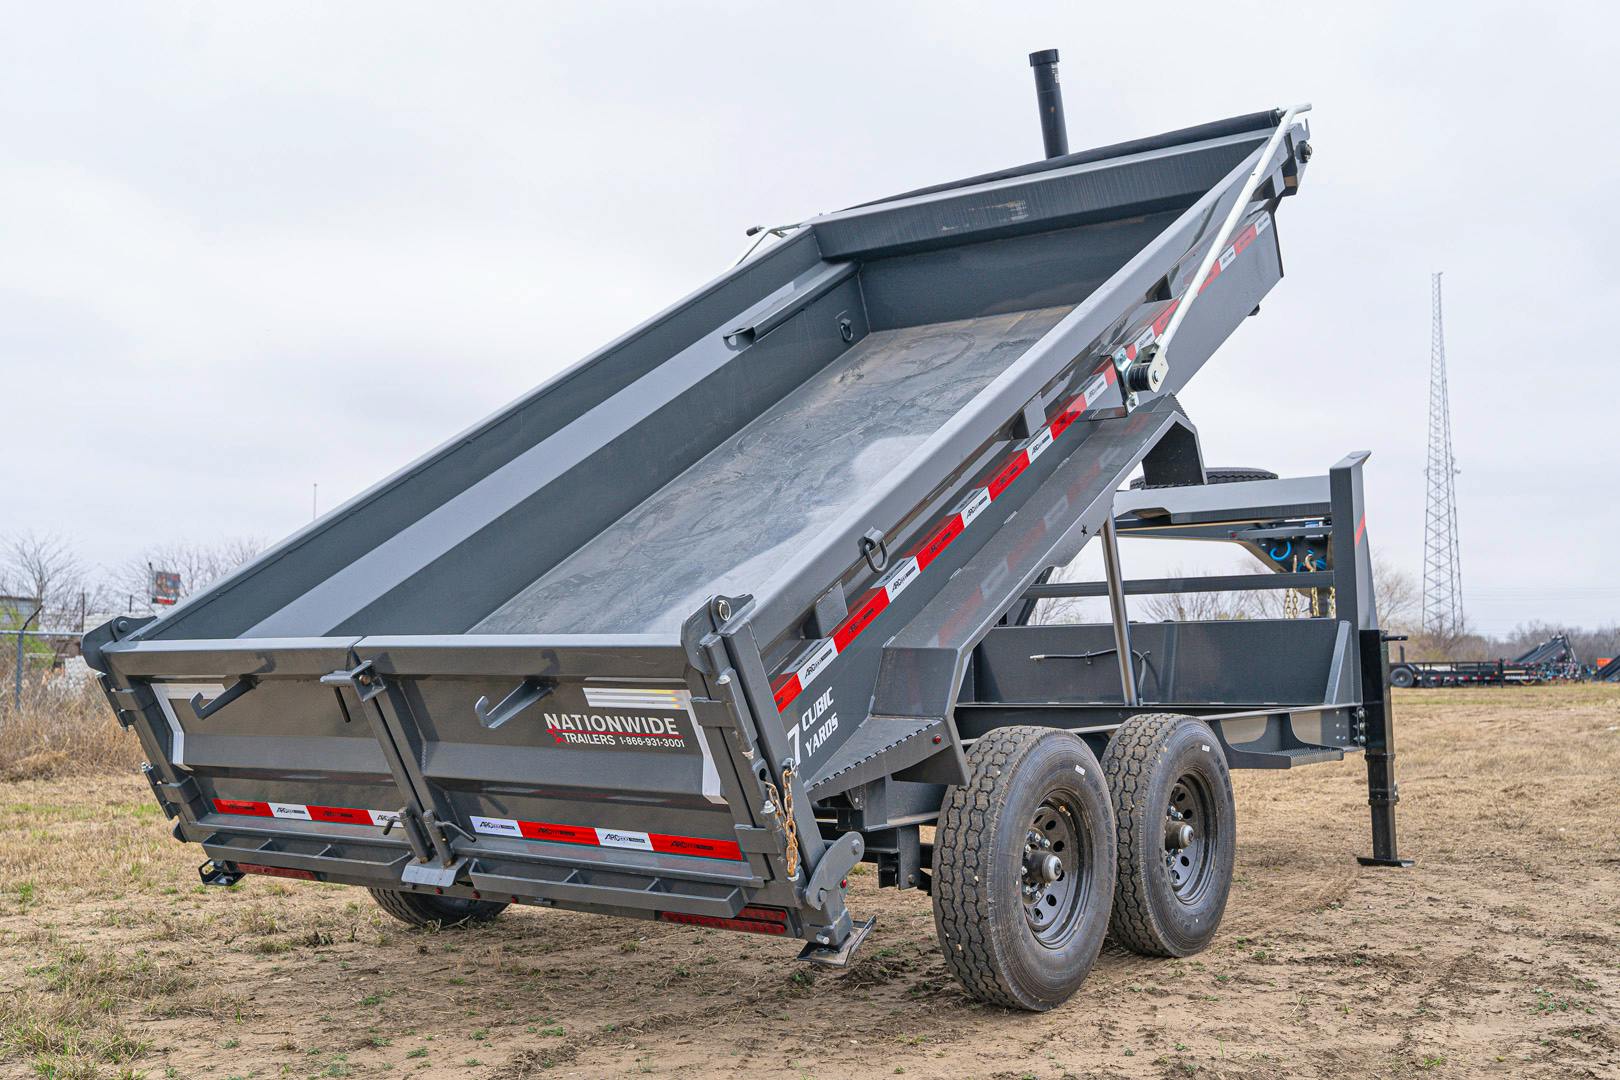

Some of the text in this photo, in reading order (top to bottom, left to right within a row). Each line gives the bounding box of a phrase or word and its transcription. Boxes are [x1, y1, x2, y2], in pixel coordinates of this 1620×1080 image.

[543, 713, 680, 736] NATIONWIDE
[801, 686, 834, 732] CUBIC
[562, 732, 685, 748] TRAILERS 1-866-931-3001
[786, 722, 801, 767] 7
[805, 712, 839, 758] YARDS
